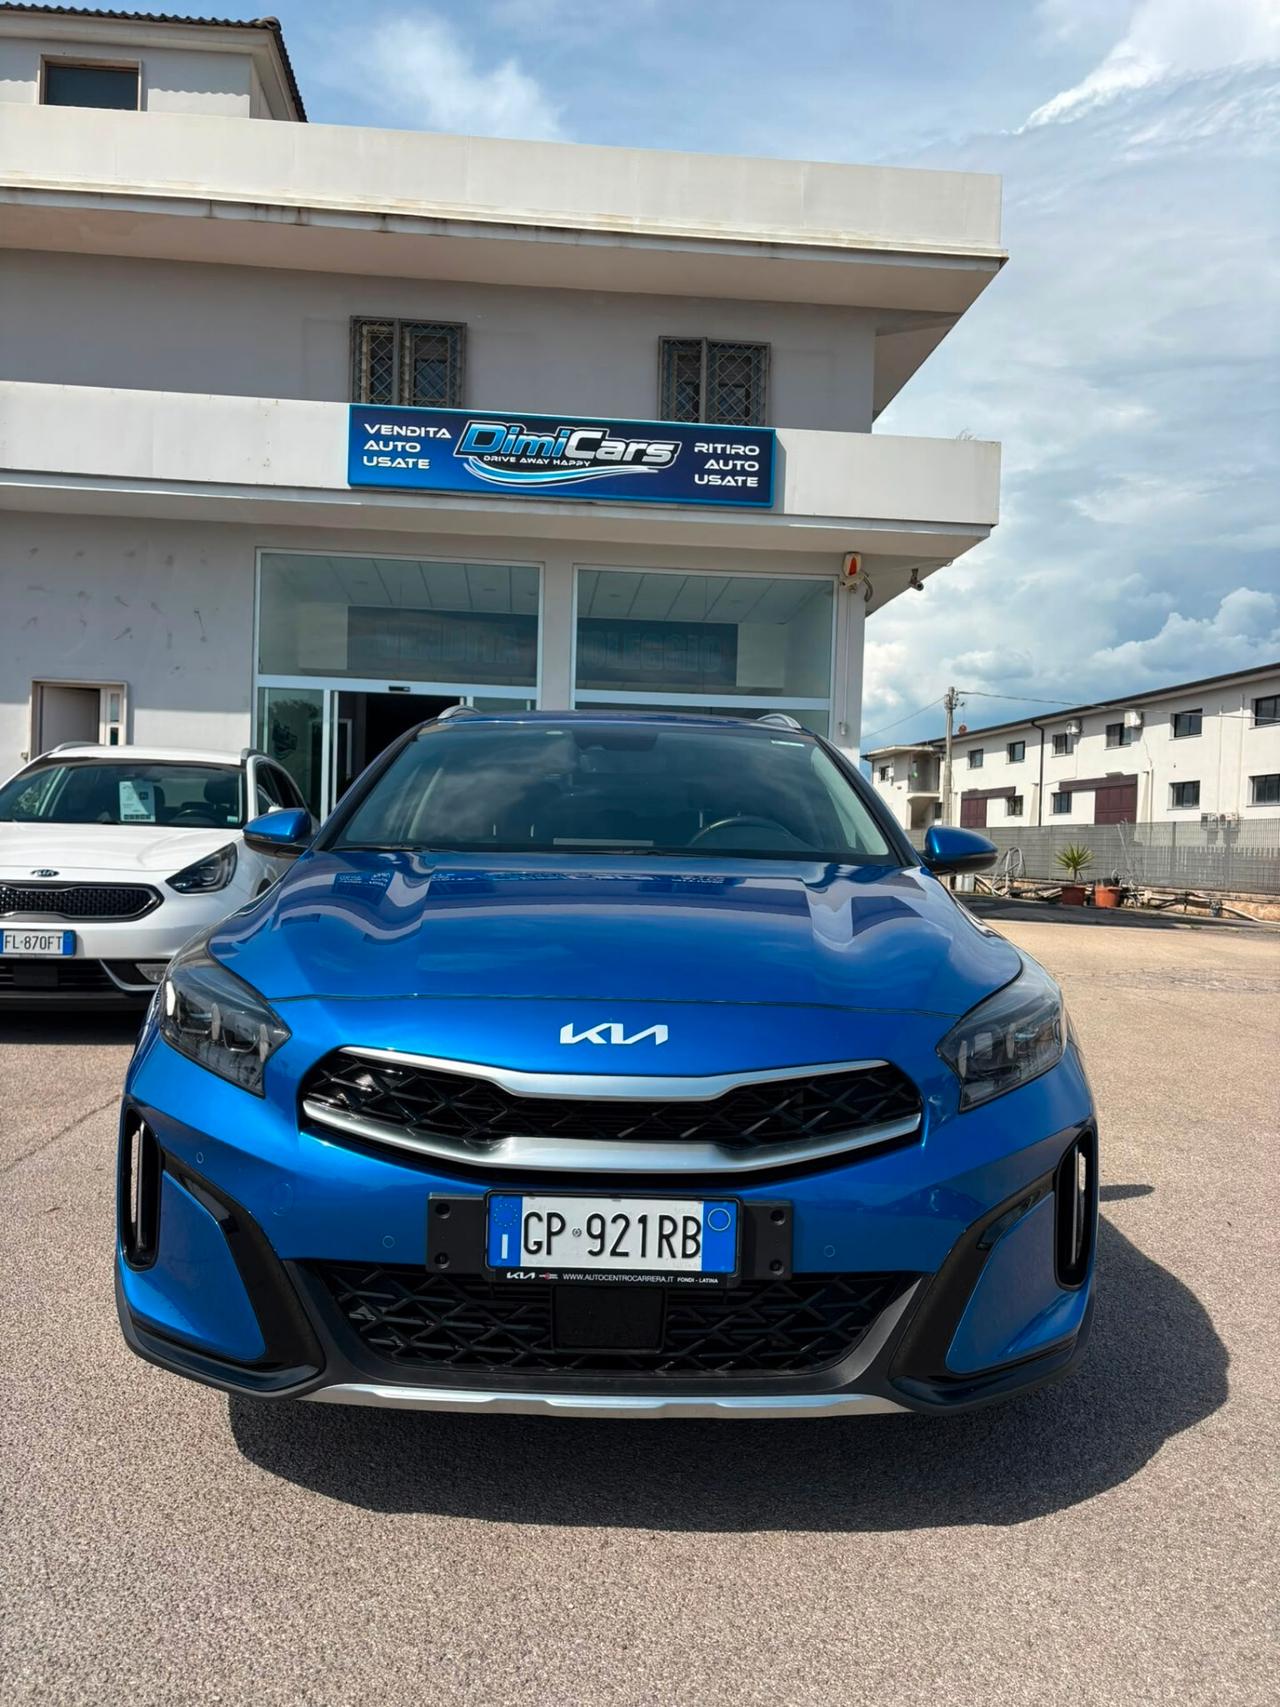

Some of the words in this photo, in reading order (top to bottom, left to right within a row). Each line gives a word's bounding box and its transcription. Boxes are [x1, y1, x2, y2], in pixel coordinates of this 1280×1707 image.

[364, 423, 452, 439] VENDITA
[363, 440, 421, 453] AUTO
[459, 423, 676, 463] DimiCars
[694, 442, 760, 456] RITIRO
[363, 455, 430, 469] USATE
[483, 455, 516, 463] DRIVE
[519, 457, 550, 465] AWAY
[553, 459, 591, 467] HAPPY
[704, 458, 759, 471] AUTO
[694, 474, 759, 487] USATE
[5, 934, 20, 950] FL
[560, 1022, 669, 1046] KIA
[523, 1211, 566, 1256] GP
[586, 1213, 702, 1259] 921RB
[506, 1271, 536, 1280] KIA
[562, 1273, 675, 1283] WWW.AUTOCENTROCARRERA.IT
